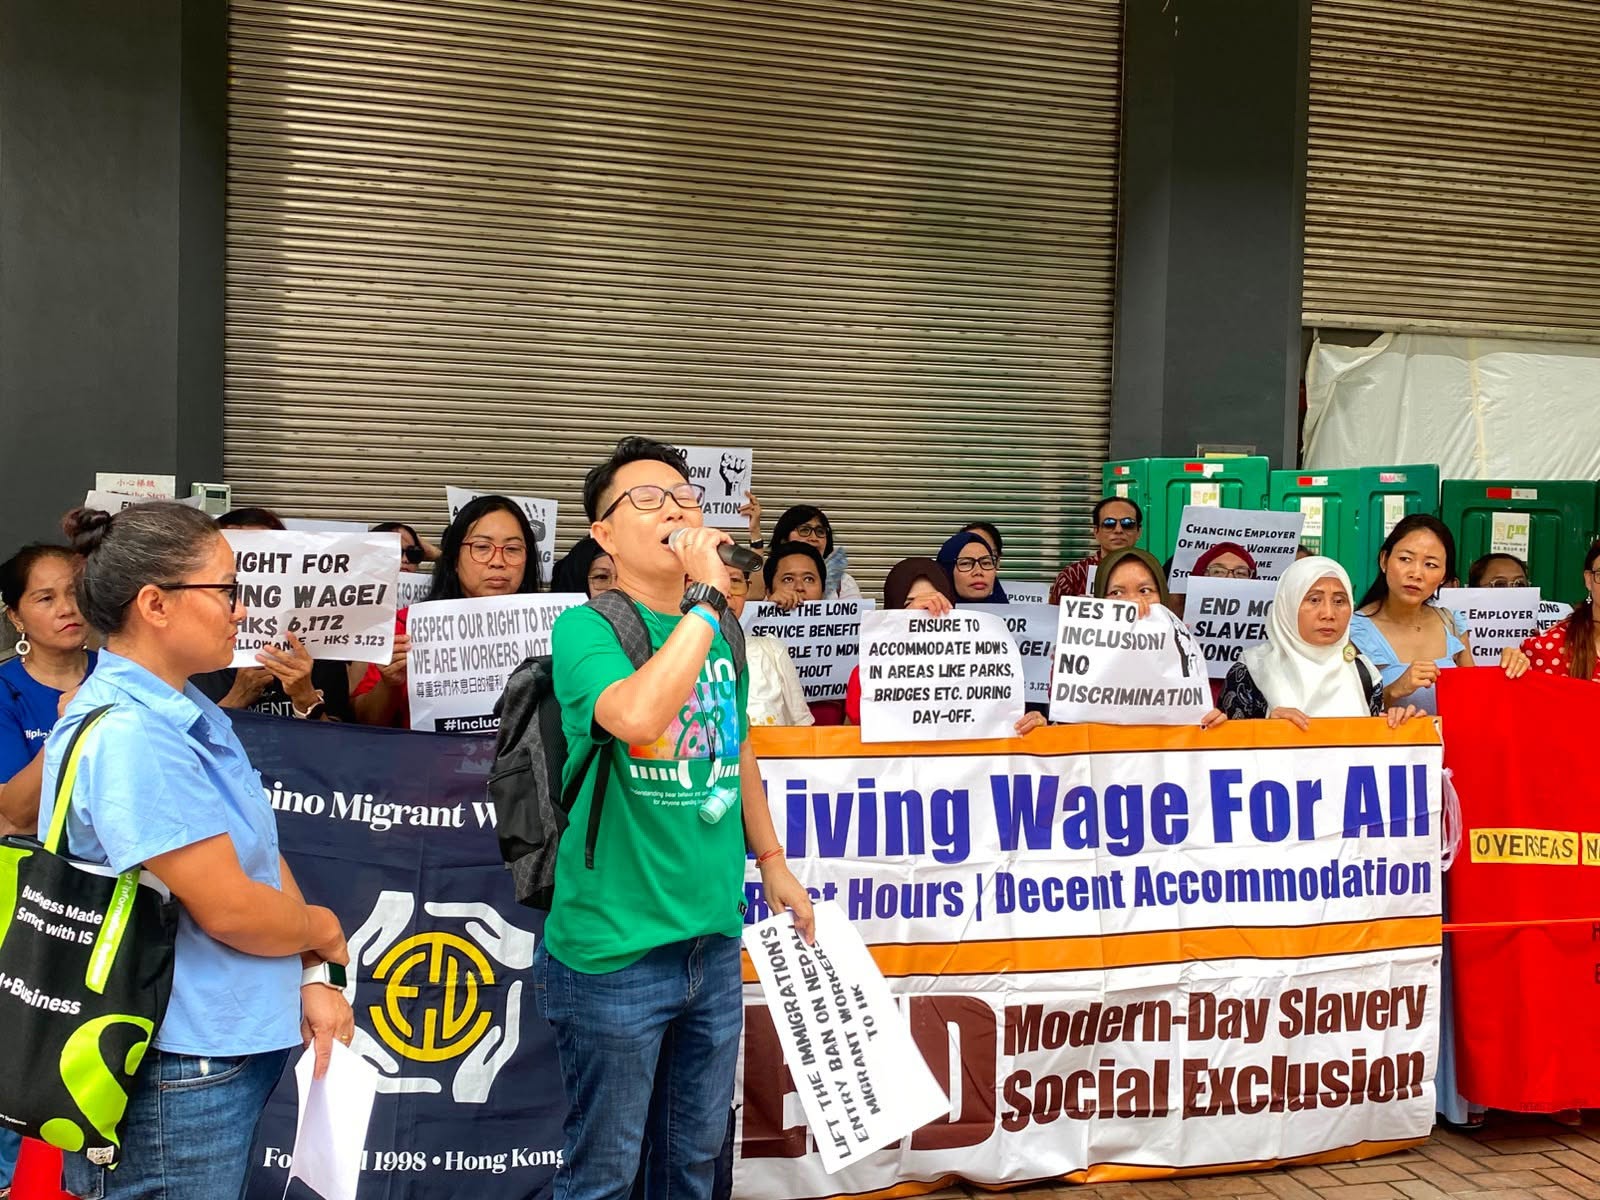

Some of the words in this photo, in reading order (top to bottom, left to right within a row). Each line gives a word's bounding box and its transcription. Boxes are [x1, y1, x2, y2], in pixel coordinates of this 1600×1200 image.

[235, 552, 292, 574] IGHT
[302, 554, 350, 574] FOR
[238, 585, 282, 609] ING
[293, 584, 387, 609] WAGE!
[1200, 597, 1241, 616] END
[796, 603, 822, 616] THE
[826, 603, 858, 616] LONG
[1065, 599, 1104, 620] YES
[1112, 604, 1138, 623] TO
[288, 614, 345, 634] 6,172
[411, 615, 455, 644] RESPECT
[458, 612, 484, 639] OUR
[487, 608, 521, 636] RIGHT
[524, 606, 539, 632] TO
[752, 625, 805, 638] SERVICE
[908, 618, 961, 633] ENSURE
[965, 619, 980, 632] TO
[1007, 618, 1027, 633] OR
[1194, 621, 1269, 640] SLAVER
[324, 634, 350, 646] HK$
[354, 635, 385, 647] 3,123
[816, 646, 832, 656] TO
[869, 642, 972, 656] ACCOMMODATE
[975, 641, 1008, 655] MDWS
[1019, 640, 1051, 656] GE!
[1472, 645, 1503, 657] CRIM
[413, 649, 431, 674] WE
[434, 647, 458, 673] ARE
[796, 665, 833, 678] HOUT
[869, 665, 883, 679] IN
[888, 665, 934, 679] AREAS
[938, 664, 966, 678] LIKE
[969, 663, 1015, 679] PARKS,
[1058, 653, 1090, 675] NO
[874, 687, 930, 702] BRIDGES
[934, 686, 963, 701] ETC.
[966, 685, 1012, 700] DURING
[1055, 683, 1204, 706] DISCRIMINATION
[329, 791, 466, 832] Migrant
[763, 777, 971, 865] iving
[990, 774, 1189, 857] Wage
[1209, 768, 1322, 843] For
[1342, 764, 1430, 839] All
[1476, 833, 1574, 859] OVERSEAS
[848, 877, 964, 921] Hours
[995, 869, 1126, 915] Decent
[1134, 857, 1432, 908] Accommodation
[65, 905, 104, 925] Made
[46, 923, 76, 942] with
[78, 930, 94, 945] IS
[814, 940, 853, 1024] WORKER
[760, 926, 816, 1066] IMMIGRATION'S
[850, 983, 868, 1010] HK
[811, 996, 830, 1024] ON
[1003, 991, 1270, 1056] Modern-Day
[1278, 984, 1428, 1036] Slavery
[863, 1015, 878, 1041] TO
[821, 1029, 843, 1072] BAN
[741, 995, 998, 1159] ED
[844, 1030, 881, 1115] MIGRANT
[807, 1070, 832, 1112] THE
[1001, 1058, 1170, 1133] Social
[1182, 1048, 1425, 1121] Exclusion
[834, 1080, 870, 1143] ENTRY
[826, 1119, 852, 1159] LIFT
[373, 1151, 427, 1172] 1998
[444, 1151, 507, 1174] Hong
[511, 1147, 564, 1169] Kong
